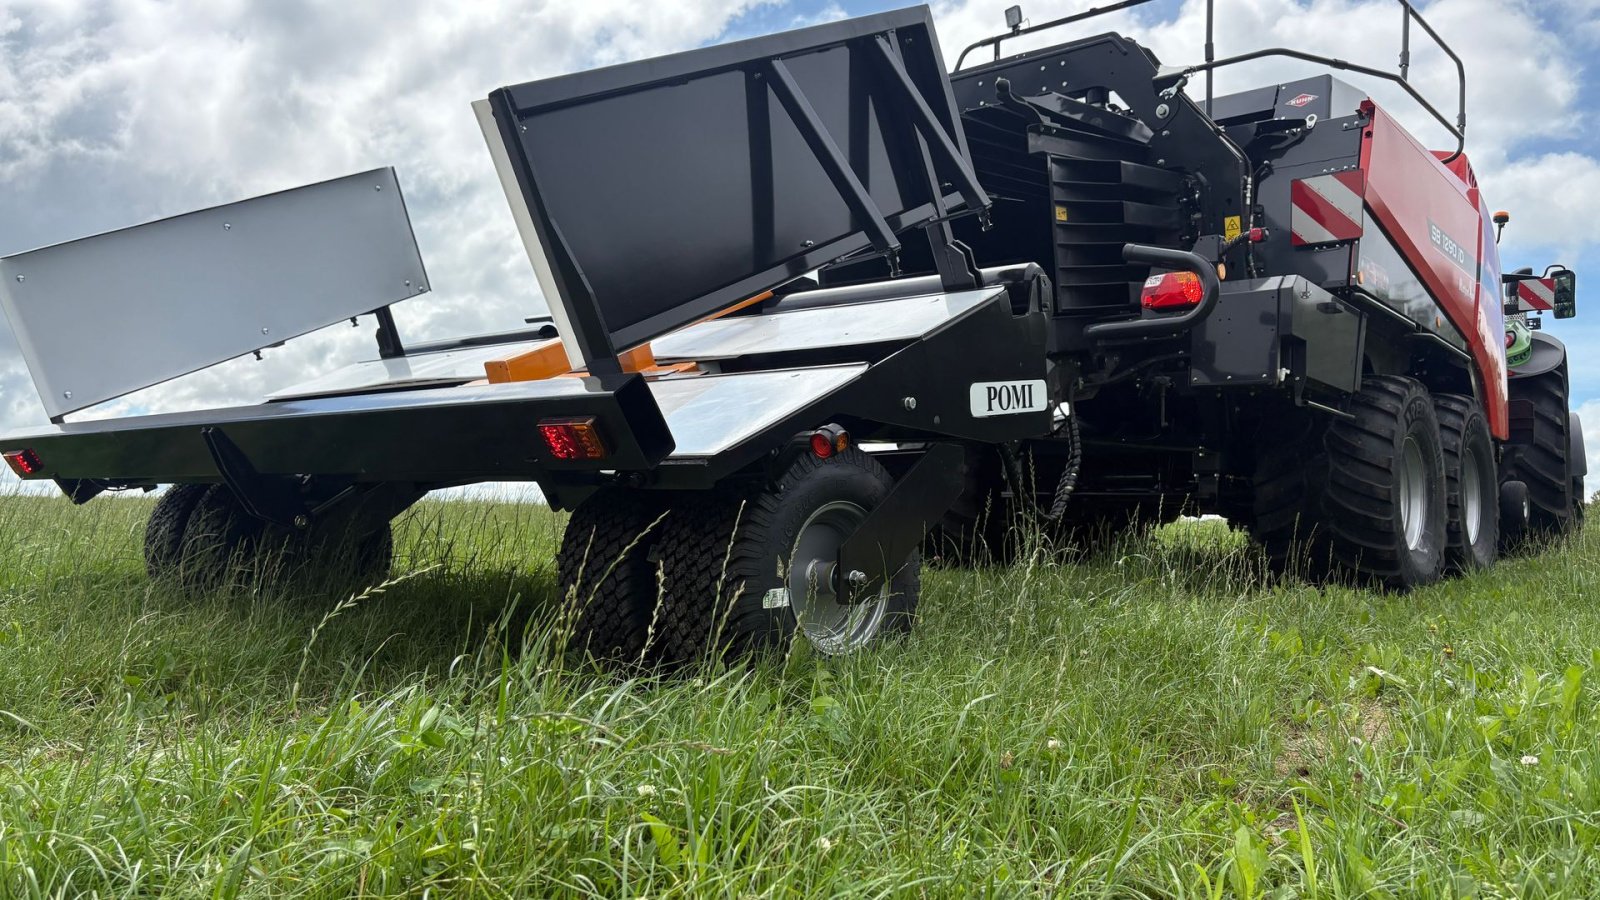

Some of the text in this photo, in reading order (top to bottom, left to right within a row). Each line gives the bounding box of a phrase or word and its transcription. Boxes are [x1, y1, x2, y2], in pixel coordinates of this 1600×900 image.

[1290, 96, 1313, 105] KUHN
[1431, 225, 1441, 245] SB
[1442, 235, 1457, 259] 1290
[986, 384, 1034, 411] POMI
